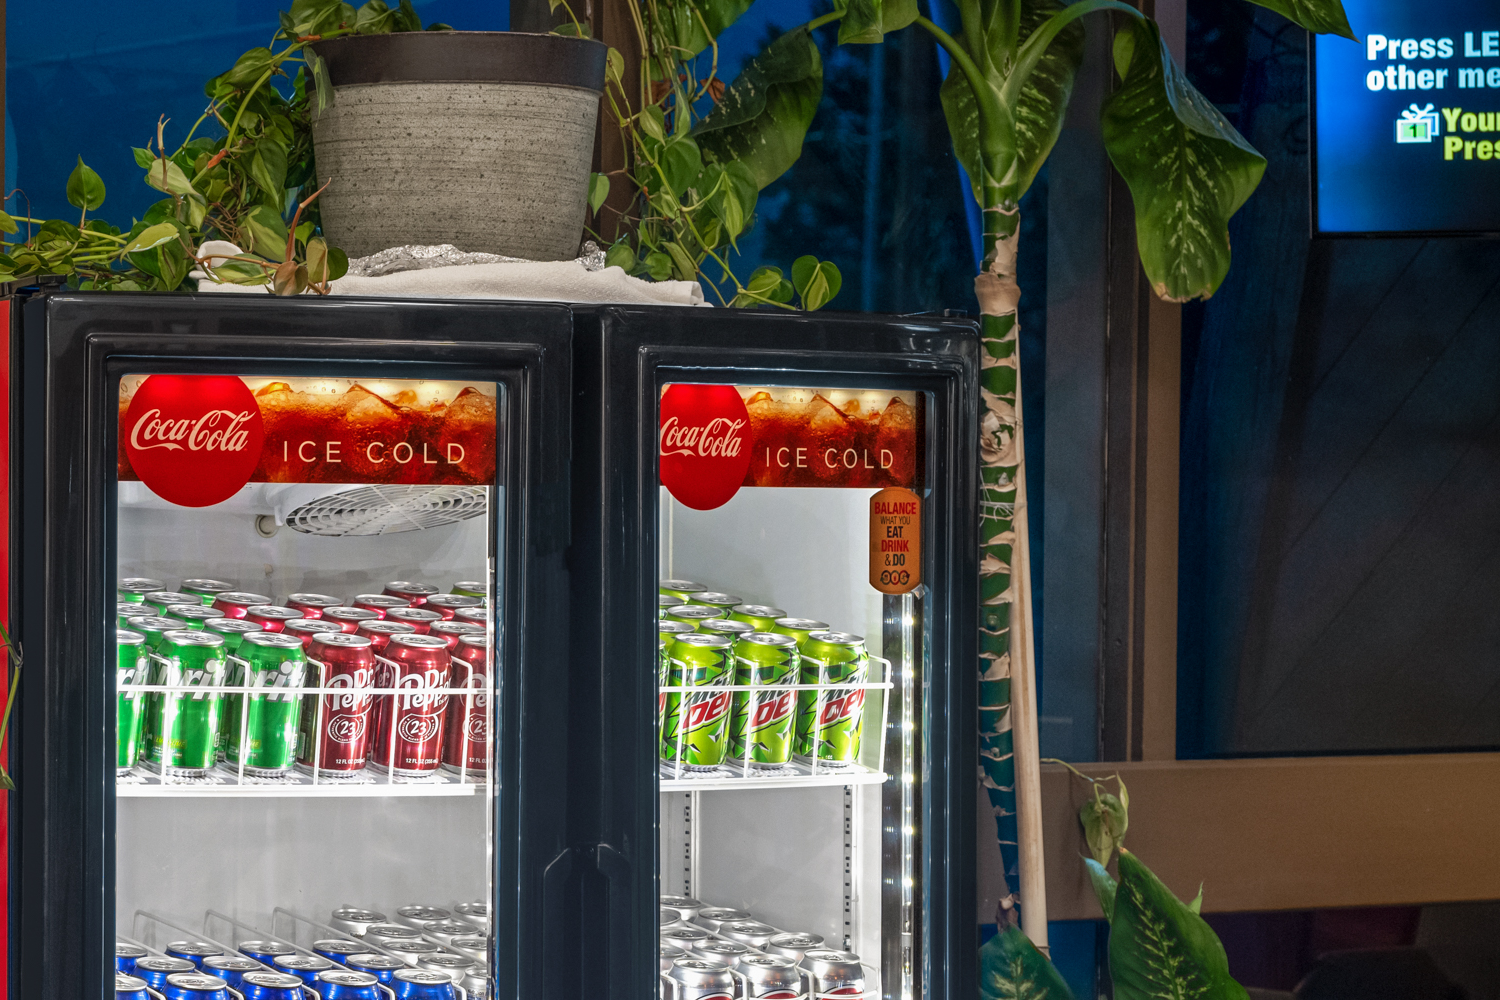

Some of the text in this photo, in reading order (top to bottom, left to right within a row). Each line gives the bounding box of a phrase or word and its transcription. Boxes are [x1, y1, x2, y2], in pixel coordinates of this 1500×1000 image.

[1366, 34, 1454, 61] Press
[1366, 64, 1449, 91] other
[130, 408, 257, 452] Coca-Cola
[660, 416, 747, 458] Coca-Cola
[283, 440, 466, 465] ICE COLD
[766, 447, 894, 469] ICE COLD
[874, 501, 917, 515] BALANCE
[880, 515, 911, 525] WHAT YOU
[881, 539, 910, 553] DRINK
[884, 553, 906, 567] & DO
[340, 720, 356, 737] 23
[410, 720, 427, 737] 23
